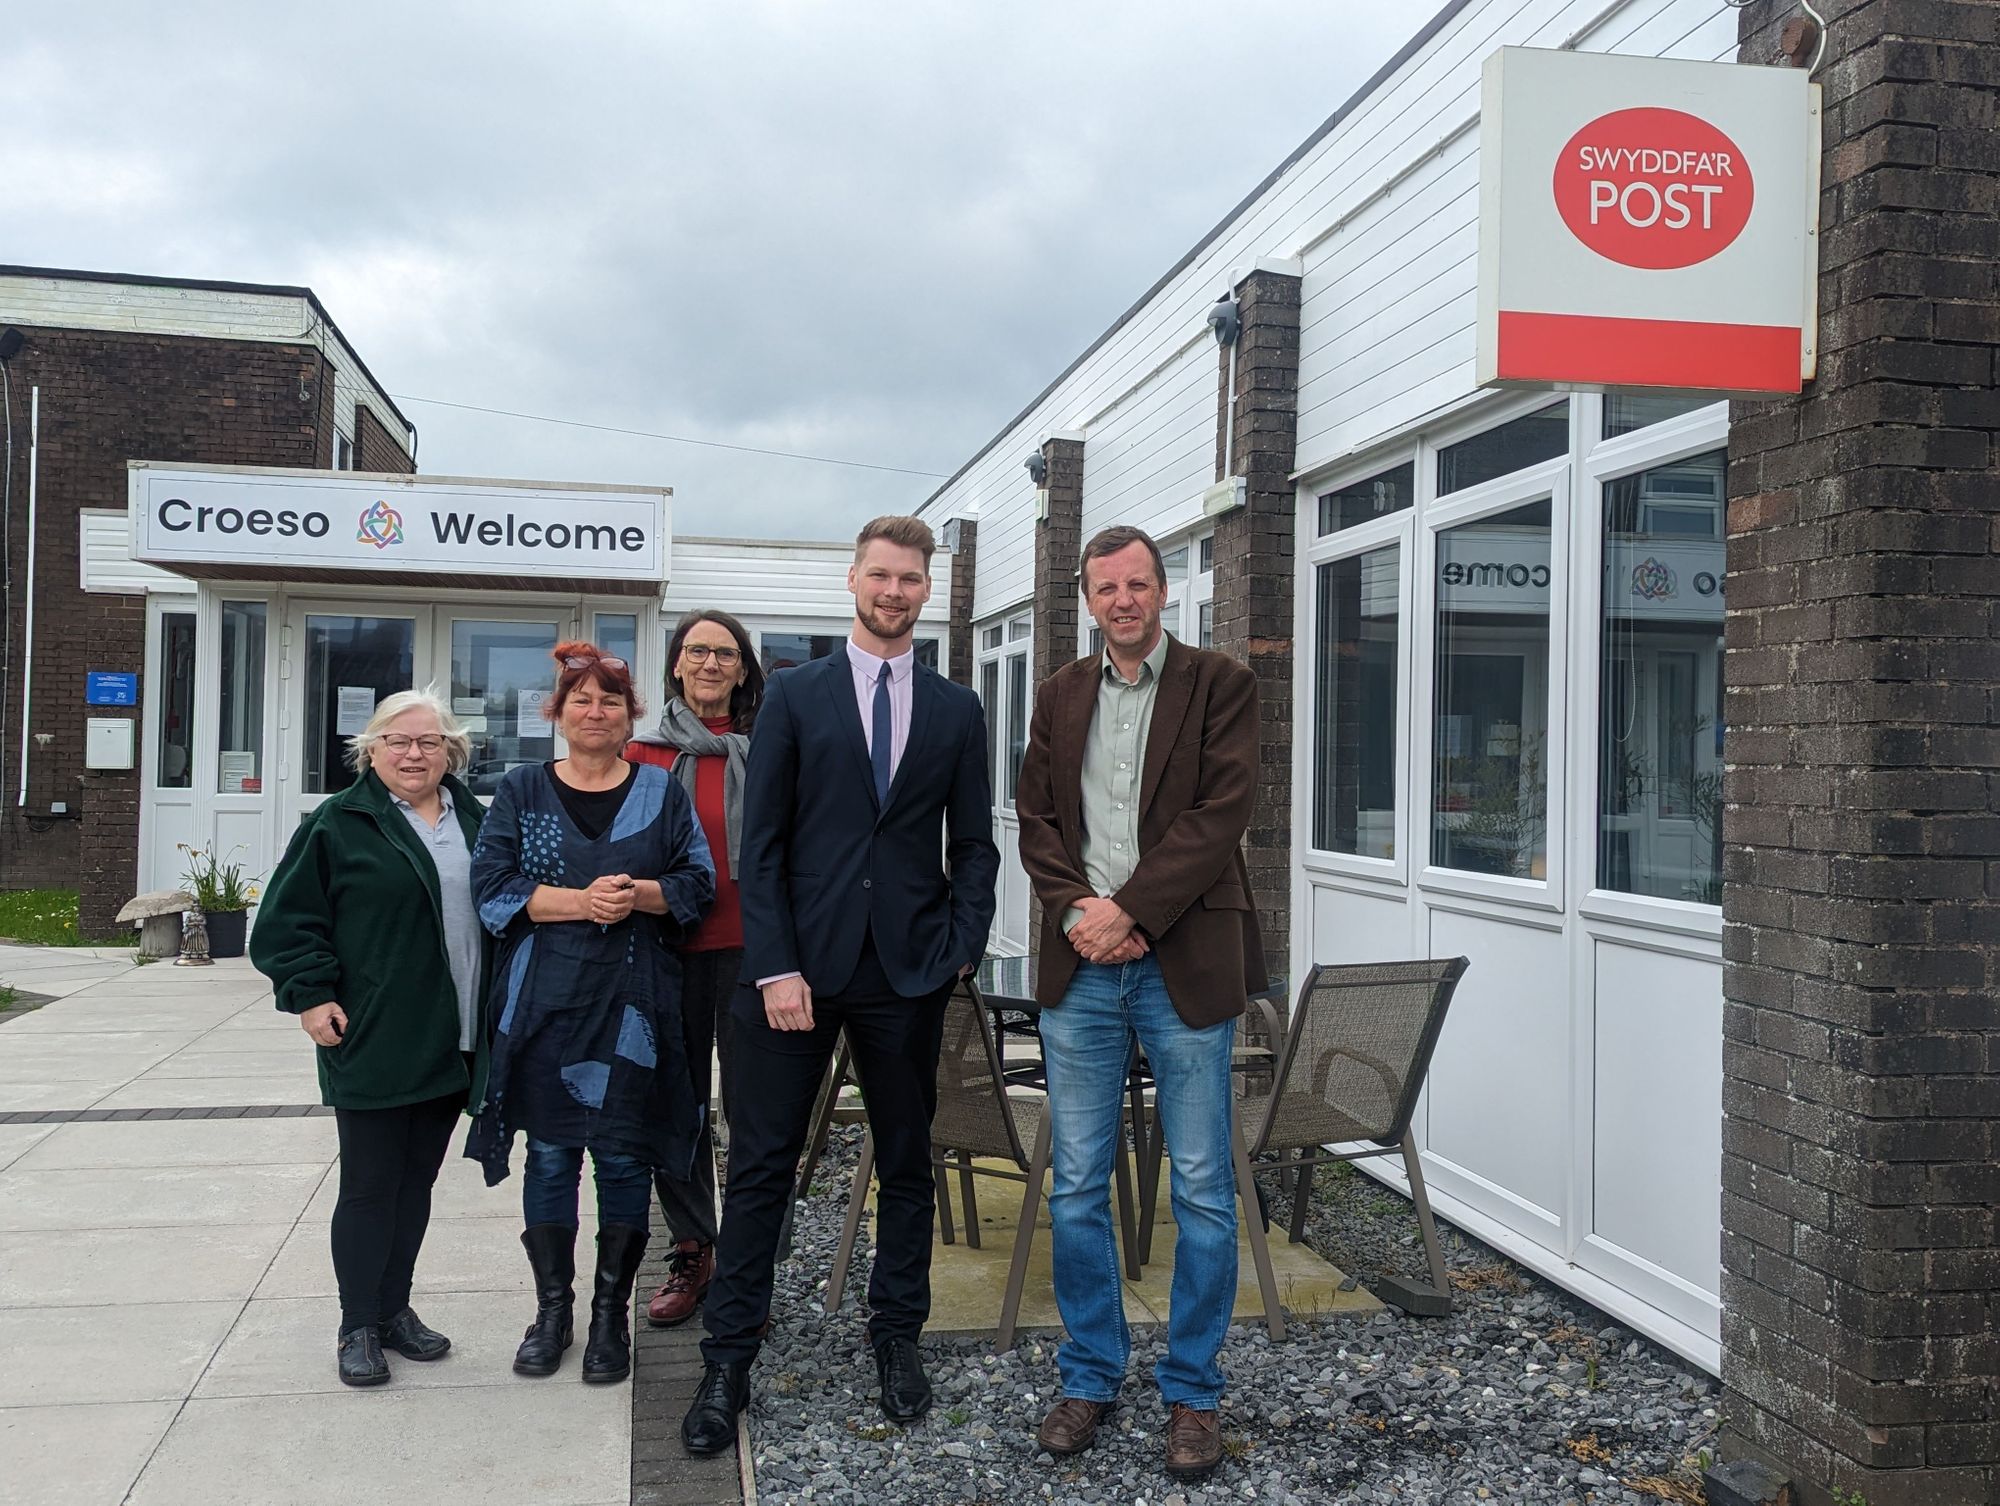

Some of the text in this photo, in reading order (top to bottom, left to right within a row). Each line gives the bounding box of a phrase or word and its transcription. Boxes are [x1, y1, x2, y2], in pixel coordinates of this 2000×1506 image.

[1579, 145, 1734, 177] SWYDDFA'R
[1590, 180, 1723, 230] POST
[158, 498, 645, 552] Croeso Welcome
